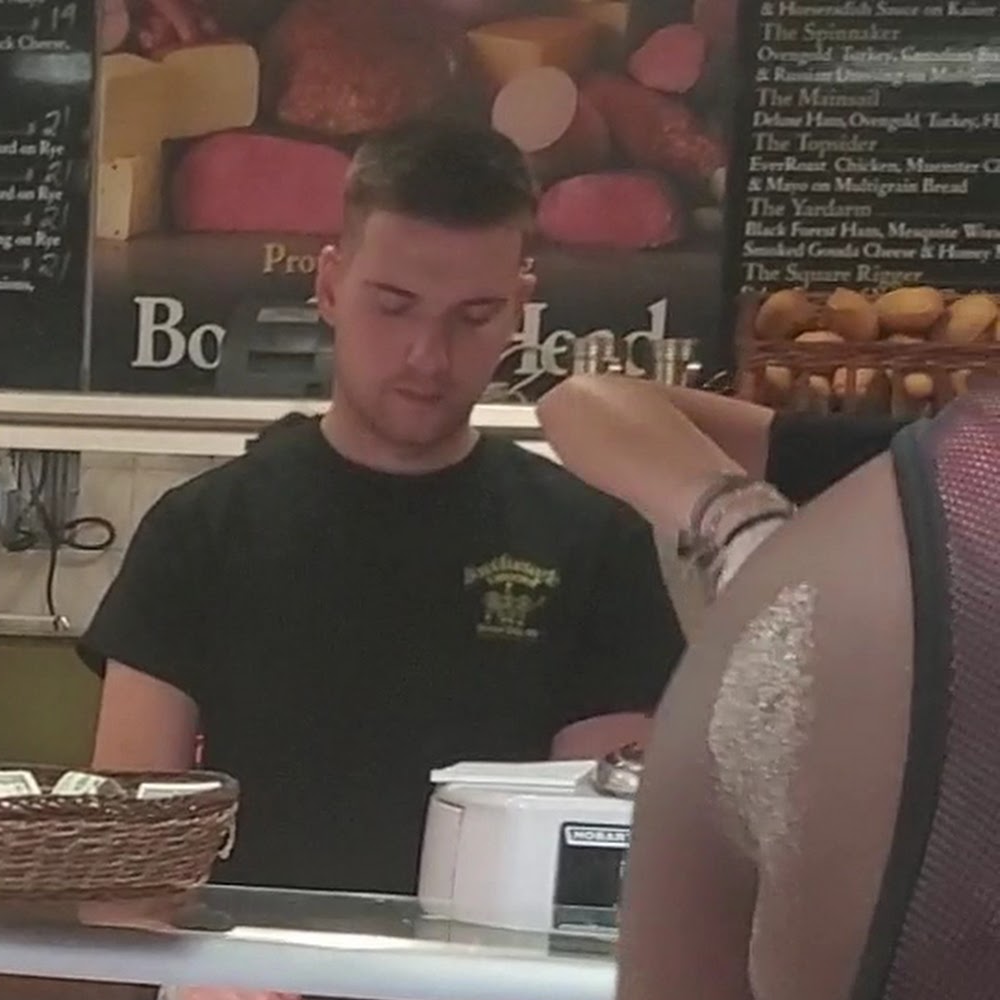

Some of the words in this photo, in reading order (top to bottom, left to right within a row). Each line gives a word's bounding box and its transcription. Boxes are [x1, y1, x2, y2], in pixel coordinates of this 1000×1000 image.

[40, 140, 64, 158] Rye
[15, 235, 32, 245] on
[35, 230, 61, 251] Rye
[573, 830, 626, 842] HOBAR
